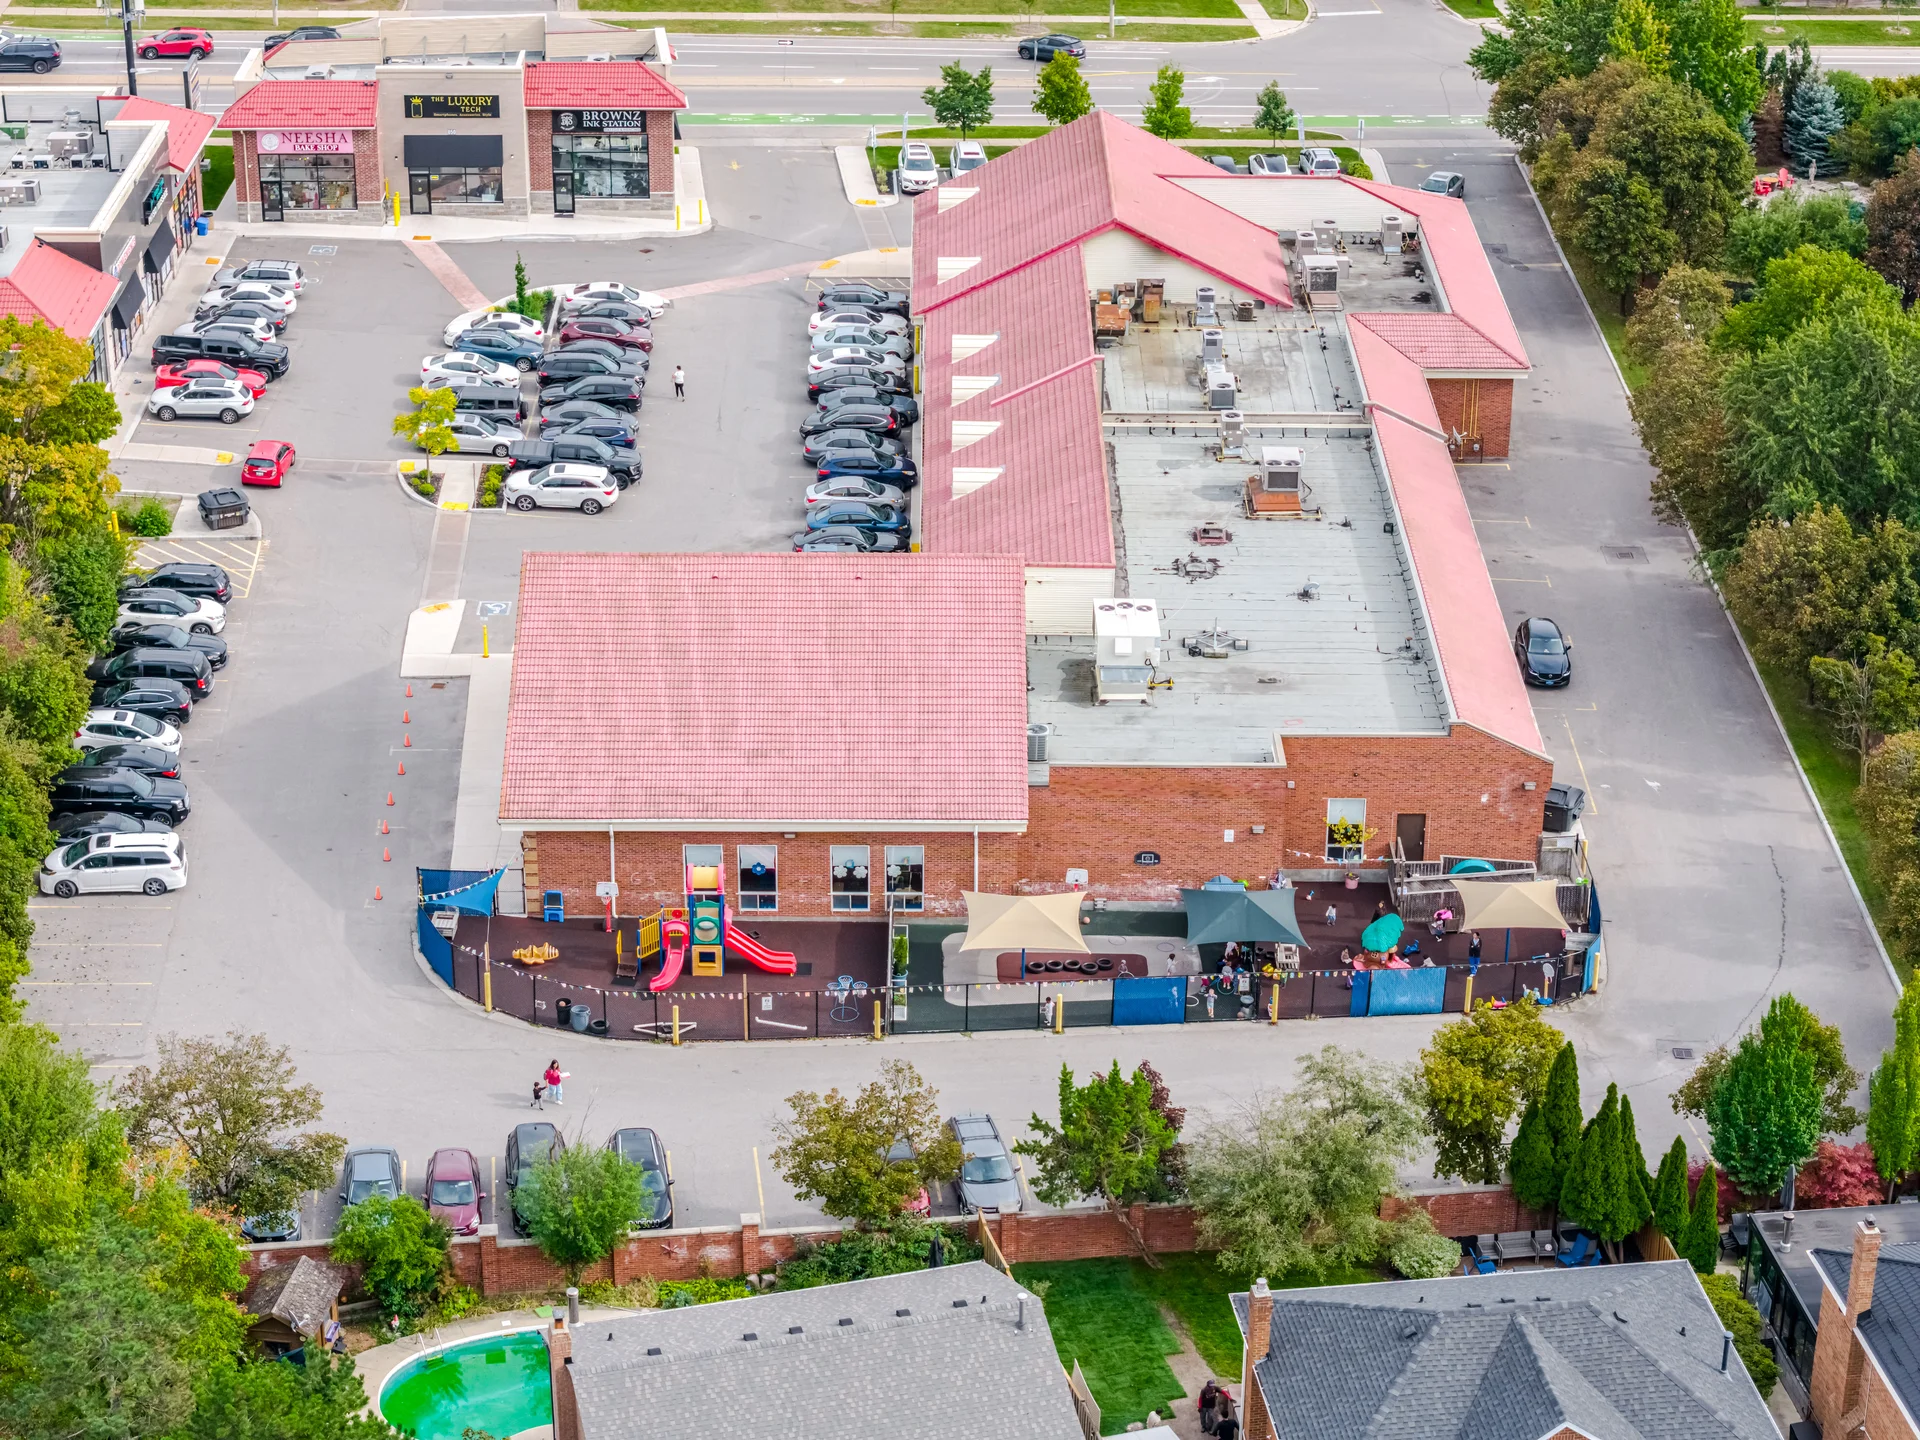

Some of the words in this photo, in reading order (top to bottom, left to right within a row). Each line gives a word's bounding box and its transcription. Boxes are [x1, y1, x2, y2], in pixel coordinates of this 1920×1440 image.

[447, 96, 493, 106] LUXURY
[582, 111, 641, 120] BROWNZ
[281, 132, 348, 143] NEESHA
